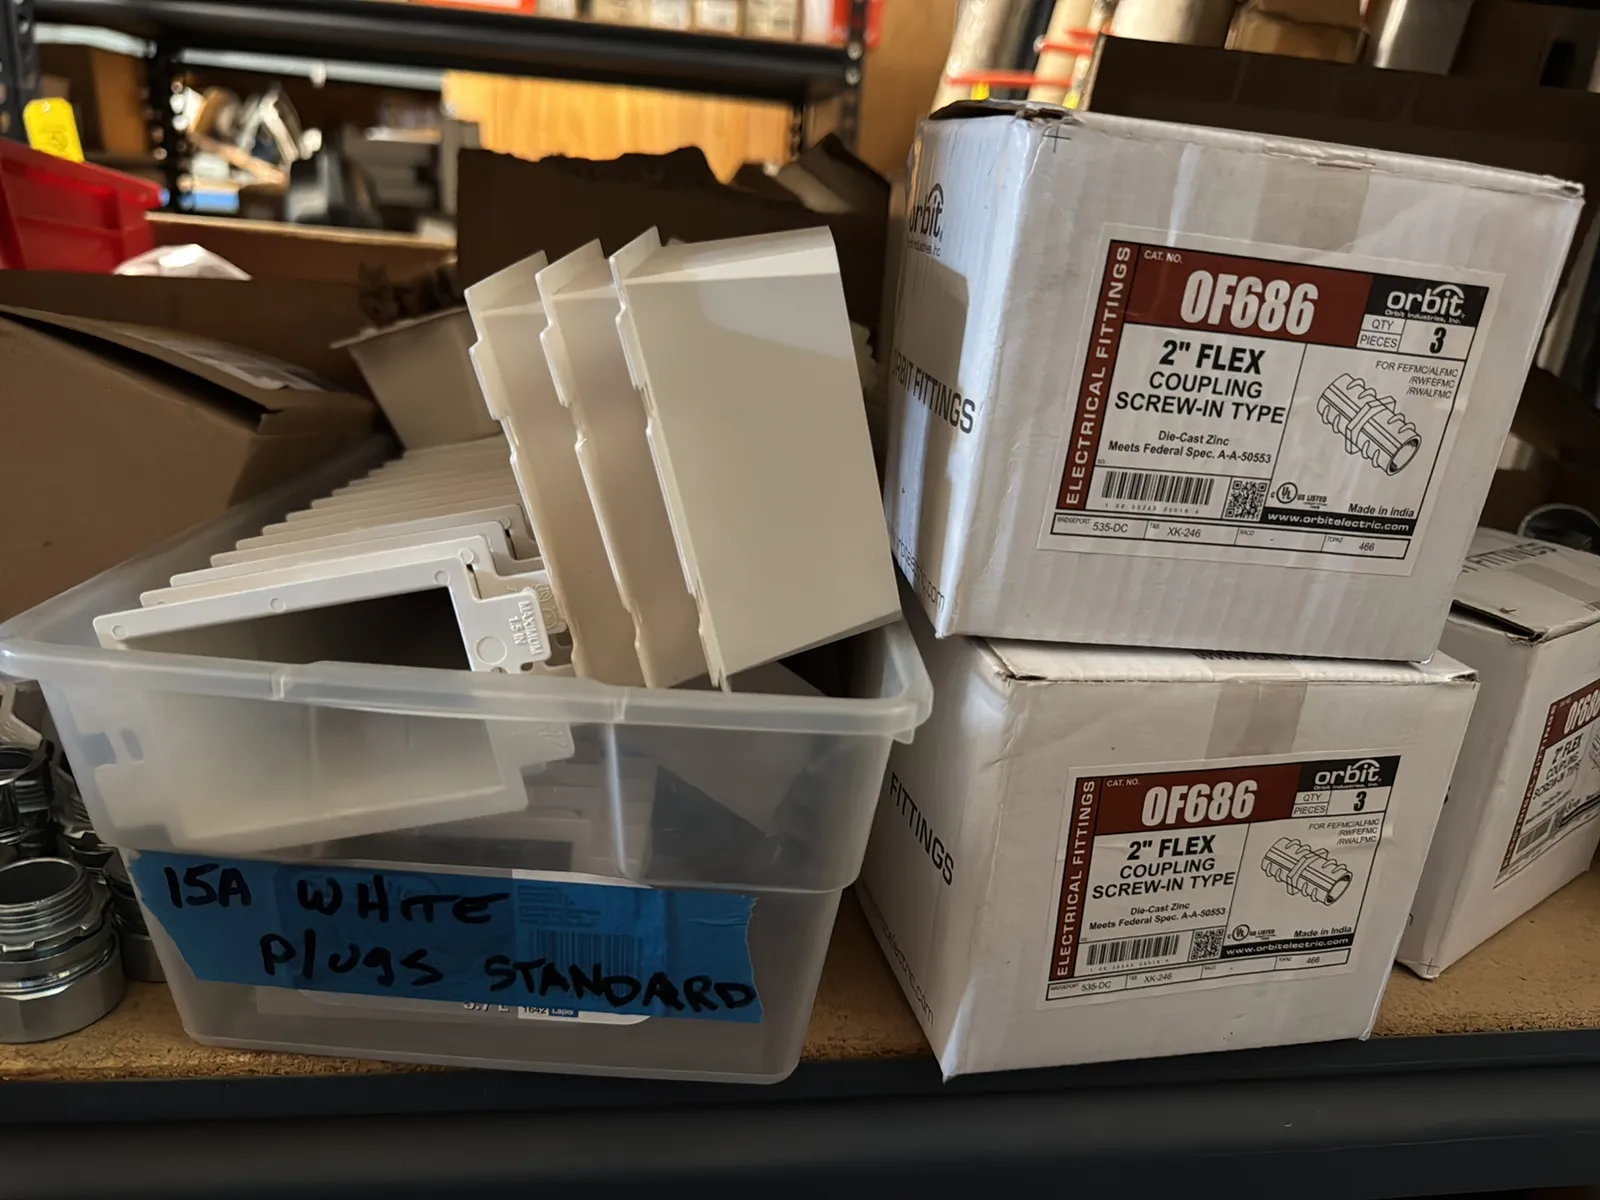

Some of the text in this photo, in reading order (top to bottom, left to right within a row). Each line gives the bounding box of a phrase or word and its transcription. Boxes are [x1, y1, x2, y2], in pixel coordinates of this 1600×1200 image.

[1144, 250, 1182, 264] CAT. NO.
[1387, 284, 1464, 317] orbit
[1372, 319, 1394, 331] QTY
[1360, 335, 1398, 348] PIECES
[1429, 327, 1447, 354] 3
[1159, 339, 1266, 375] 2" FLEX
[1066, 247, 1131, 504] ELECTRICAL FITTINGS
[1375, 361, 1458, 377] FOR FEFMC/ALFMC
[1149, 371, 1263, 399] COUPLING
[1409, 376, 1455, 388] /RWFEFMC
[914, 364, 976, 434] FITTINGS
[1406, 388, 1452, 399] /RWALFMC
[1115, 391, 1286, 424] SCREW-IN TYPE
[1158, 431, 1230, 446] Die-Cast Zinc
[1108, 440, 1272, 464] Meets Federal Spec. A-A-50553
[1348, 503, 1415, 518] Made in India
[1092, 521, 1128, 533] 535-DC
[1167, 527, 1201, 538] XK-246
[1267, 513, 1409, 532] www.orbitelectric.com
[1359, 542, 1375, 551] 466
[1314, 759, 1380, 785] orbit
[1107, 778, 1140, 787] CAT. NO.
[1303, 794, 1321, 802] QTY
[1353, 791, 1367, 812] 3
[1294, 805, 1326, 815] PIECES
[889, 771, 954, 886] FITTINGS
[1127, 834, 1216, 861] 2" FLEX
[1120, 857, 1216, 879] COUPLING
[1057, 781, 1095, 976] ELECTRICAL FITTINGS
[1092, 872, 1236, 900] SCREW-IN TYPE
[1089, 907, 1226, 930] Meets Federal Spec. A-A-50553
[1130, 902, 1190, 916] Die-Cast Zinc
[1294, 930, 1318, 938] Made
[1331, 926, 1352, 934] India
[483, 955, 760, 1012] STANDARD
